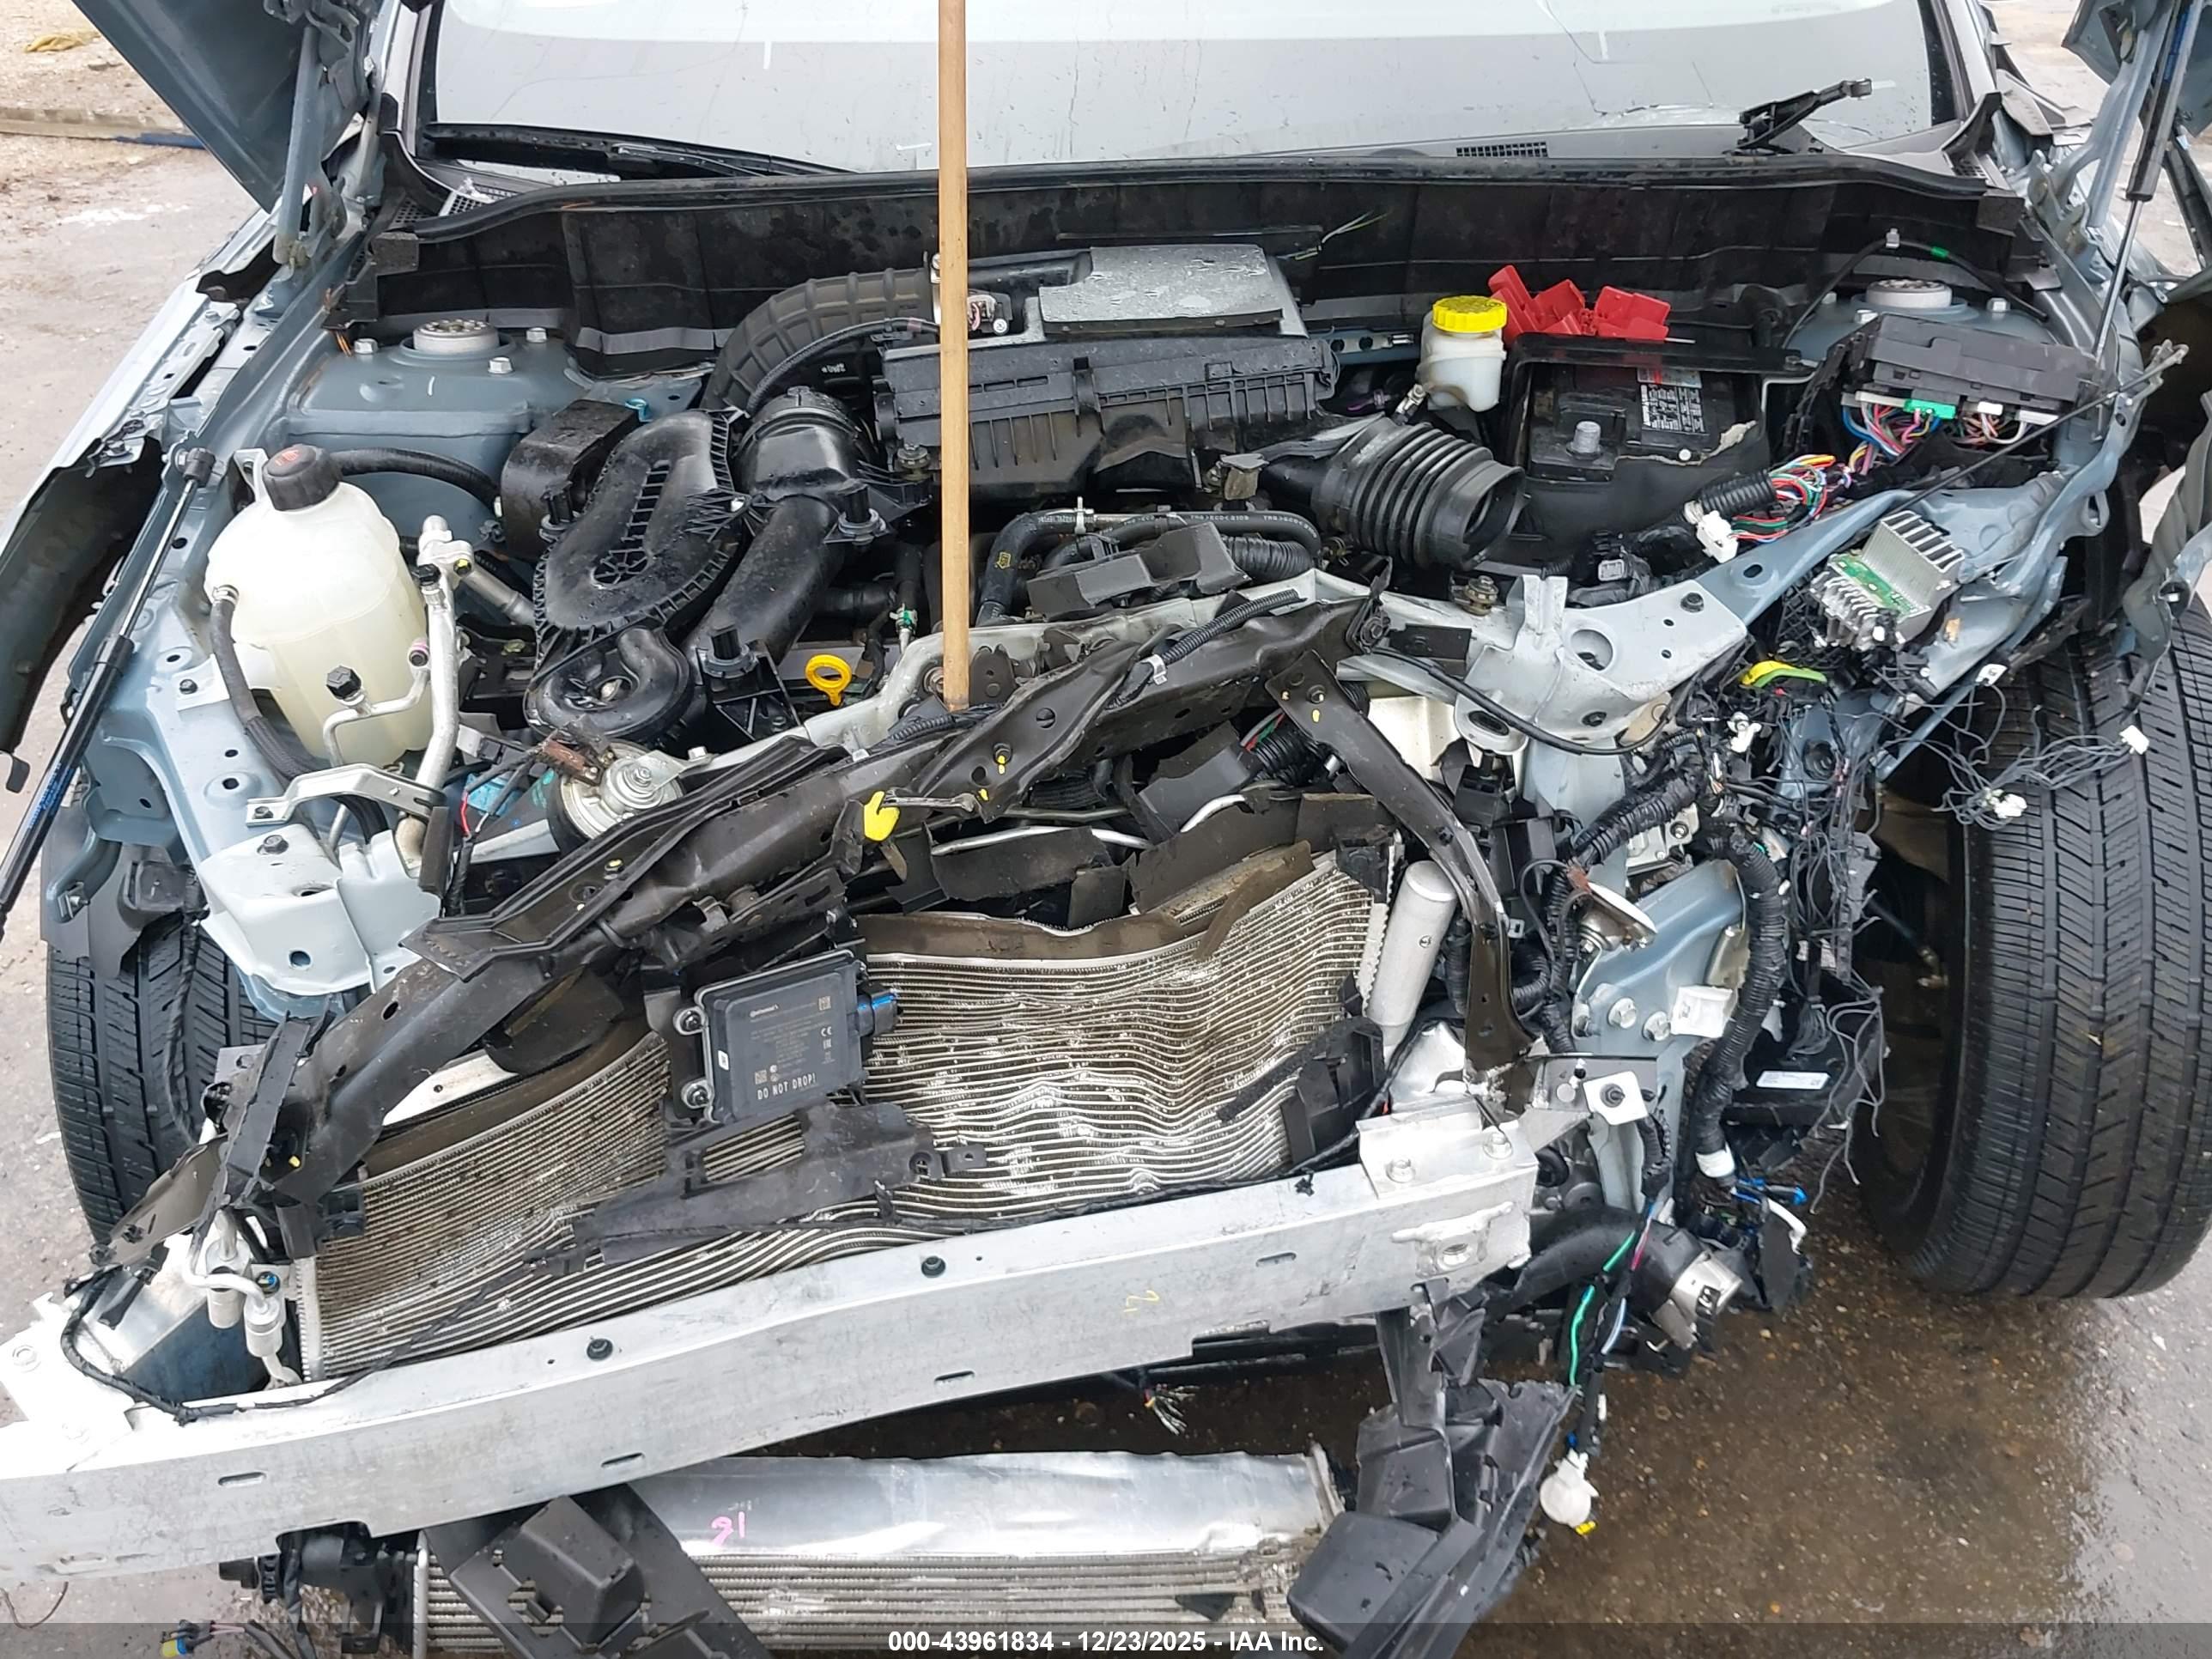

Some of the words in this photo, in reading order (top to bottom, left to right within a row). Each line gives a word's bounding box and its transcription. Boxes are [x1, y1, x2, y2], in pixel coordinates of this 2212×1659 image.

[757, 1087, 769, 1100] DO
[773, 1081, 788, 1096] NOT
[792, 1073, 816, 1090] DROP!
